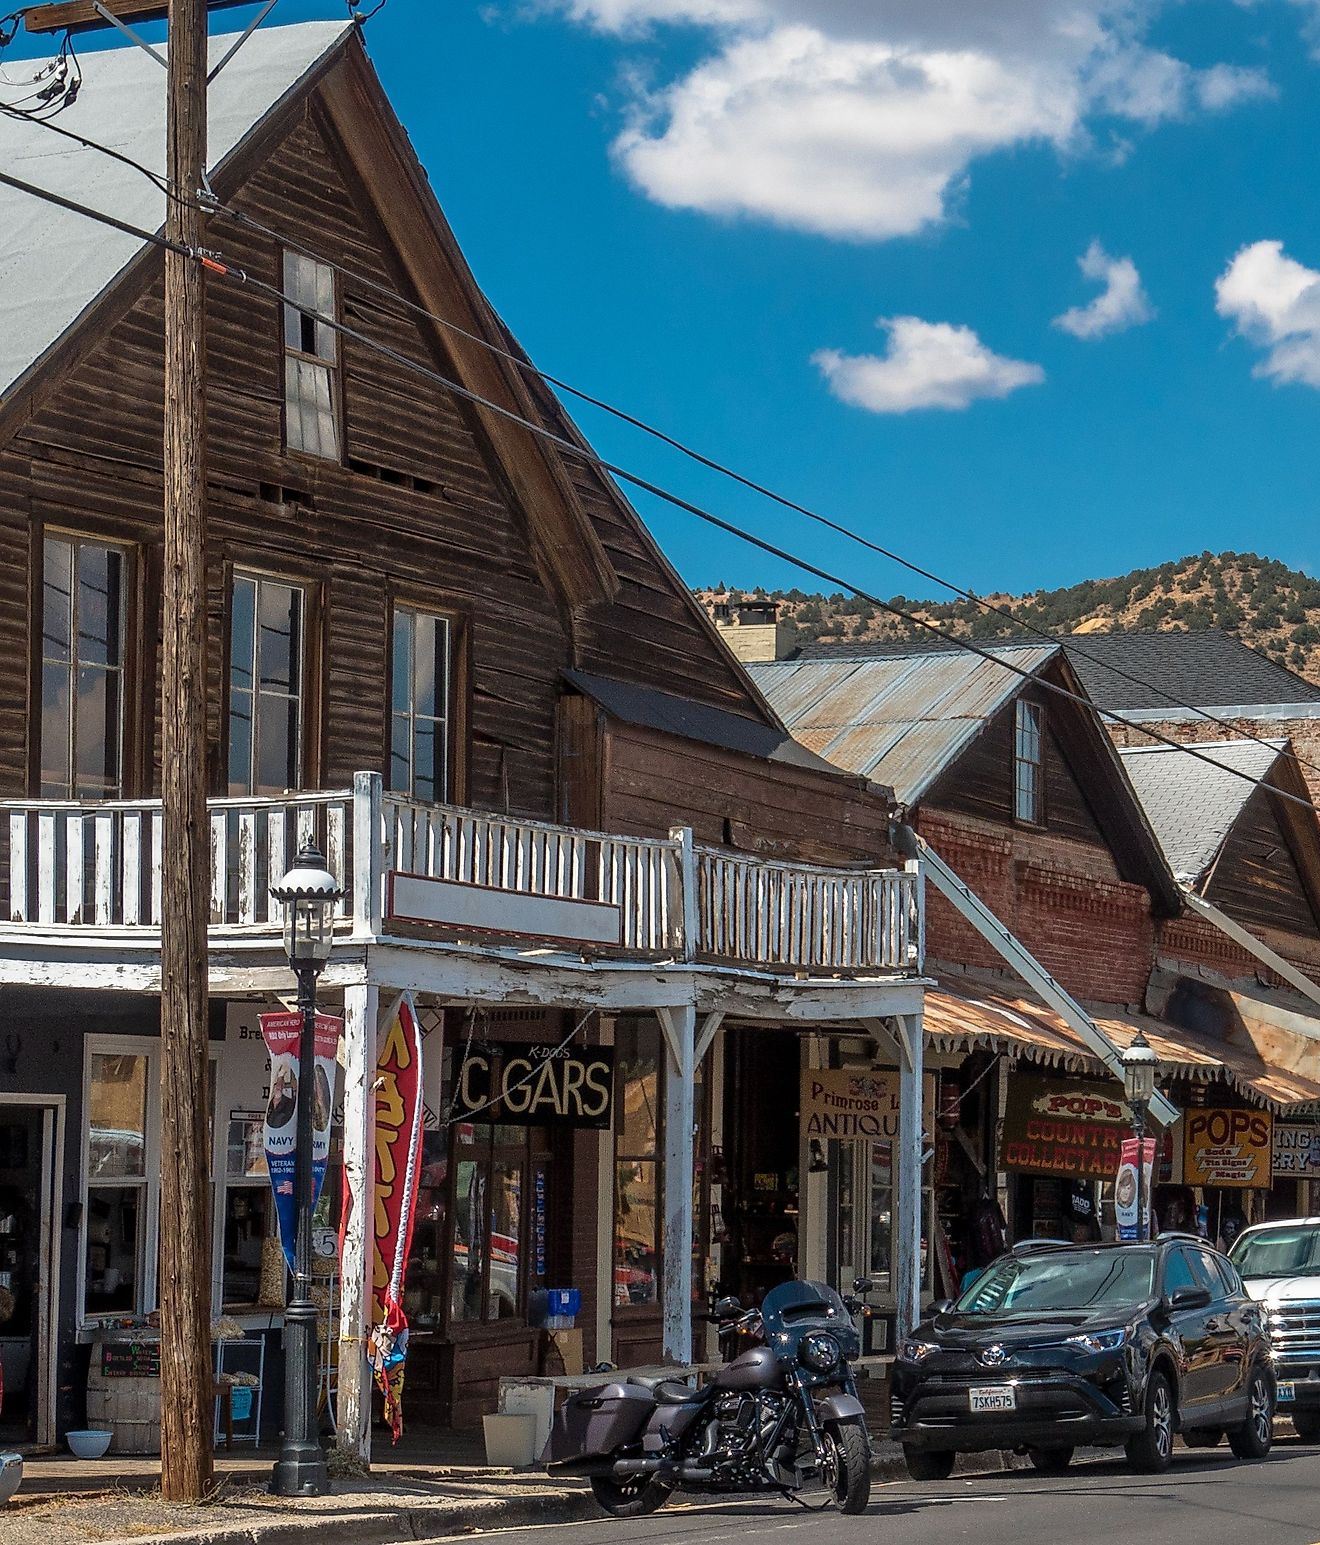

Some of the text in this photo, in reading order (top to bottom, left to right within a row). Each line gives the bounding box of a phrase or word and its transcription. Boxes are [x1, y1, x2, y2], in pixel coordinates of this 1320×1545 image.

[811, 1081, 879, 1111] Primrose
[807, 1112, 900, 1137] ANTIQU
[1189, 1111, 1269, 1148] POPS
[268, 1136, 294, 1146] NAVY
[313, 1141, 326, 1150] RMY
[972, 1395, 1013, 1408] 7SKH575
